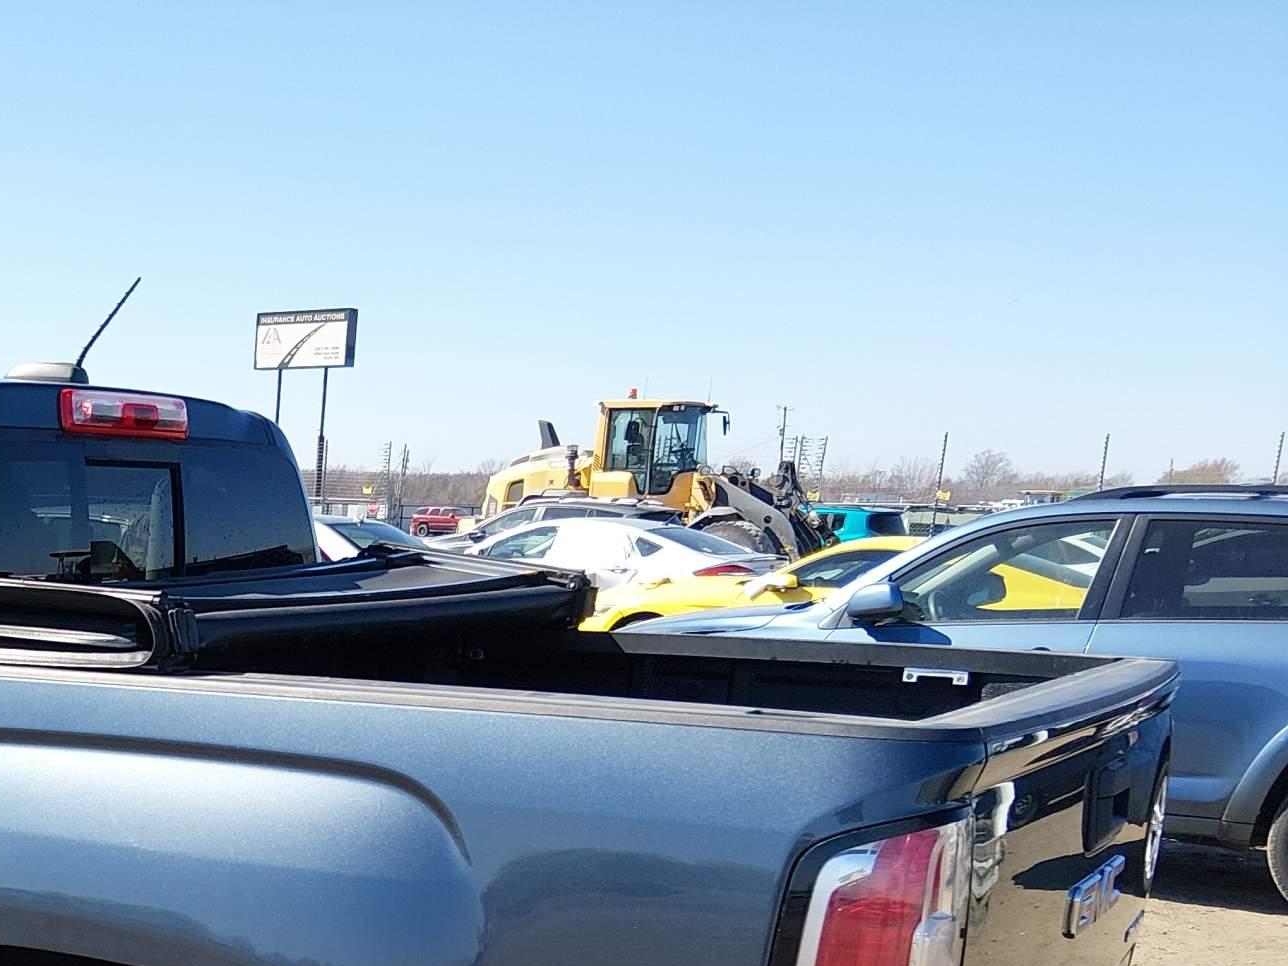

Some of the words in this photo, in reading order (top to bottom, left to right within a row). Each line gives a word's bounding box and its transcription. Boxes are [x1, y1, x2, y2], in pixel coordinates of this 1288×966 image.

[261, 315, 295, 325] INSURANCE
[295, 313, 313, 323] AUTO
[314, 312, 345, 321] AUCTIONS
[1062, 855, 1126, 938] GMC
